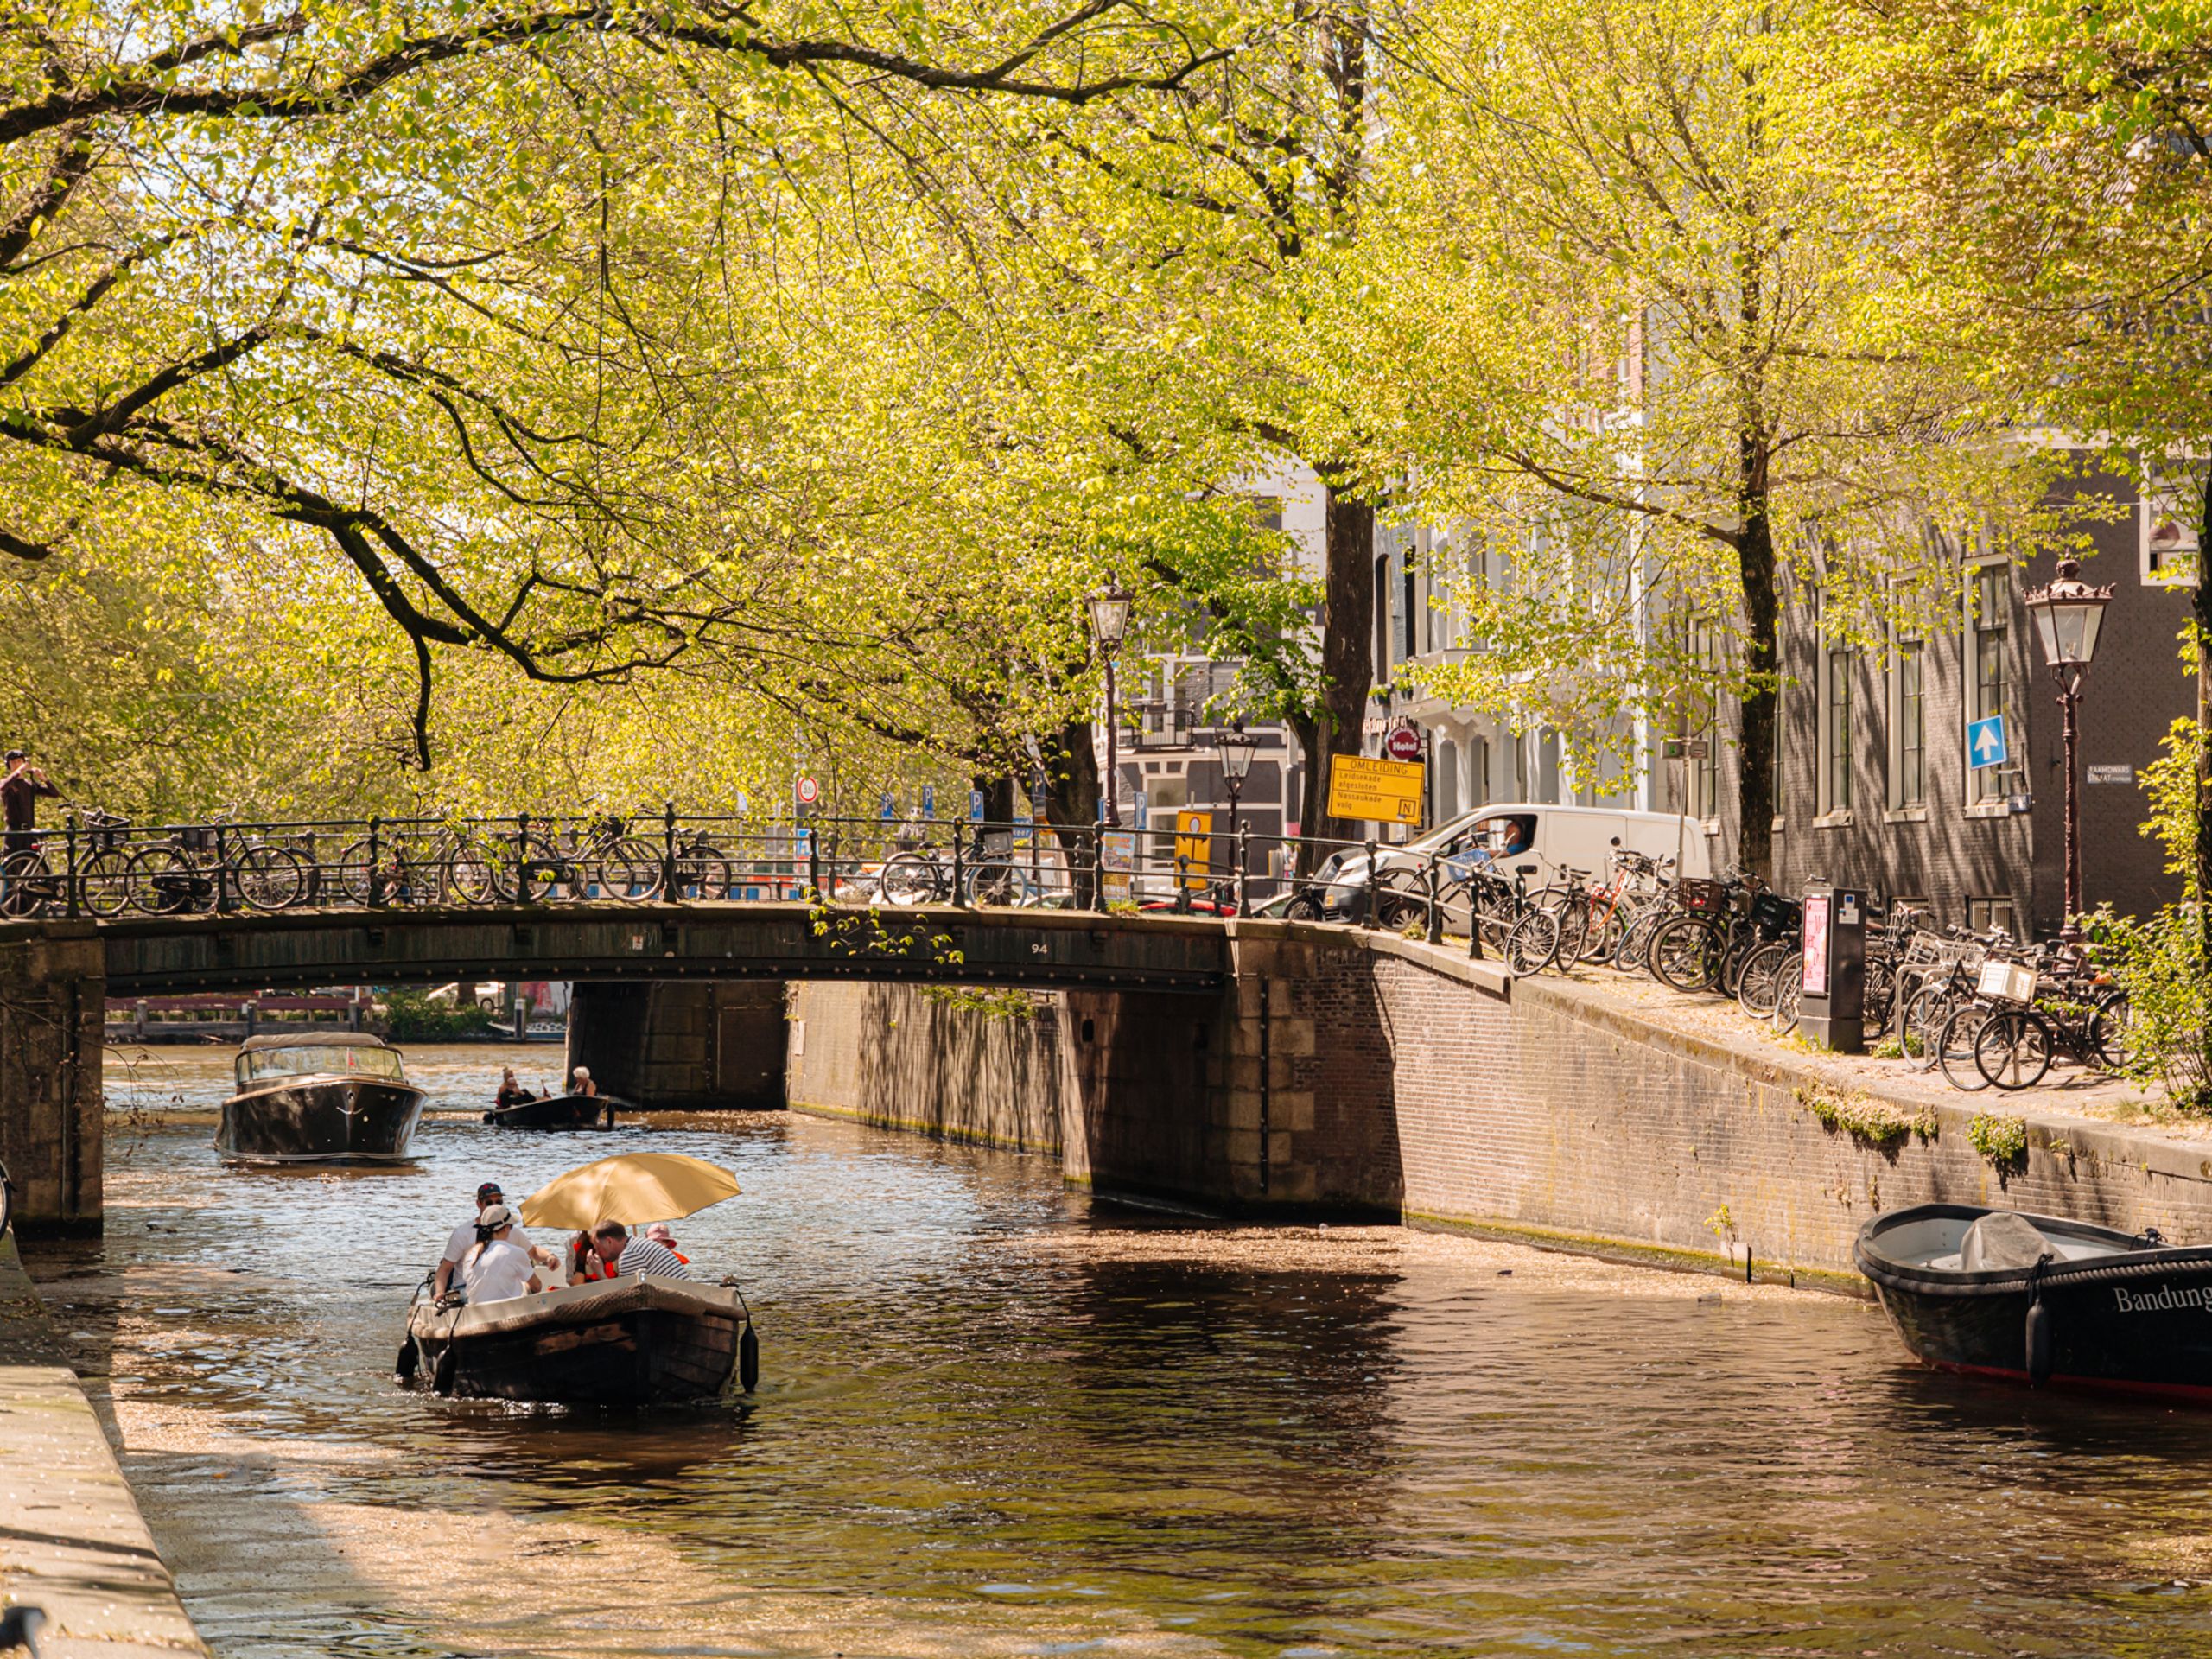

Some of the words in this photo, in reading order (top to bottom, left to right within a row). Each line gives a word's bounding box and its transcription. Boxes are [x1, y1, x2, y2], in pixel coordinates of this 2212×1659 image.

[1393, 741, 1417, 751] Hotel
[1351, 760, 1408, 774] OMLEIDING
[1339, 772, 1382, 783] Leidsekade
[1338, 782, 1378, 791] afgesloten
[925, 788, 931, 805] P
[1338, 791, 1382, 803] Nassaukade
[974, 794, 981, 812] P
[1337, 802, 1352, 810] volg
[1402, 803, 1412, 813] N
[1138, 796, 1145, 826] P
[1031, 943, 1048, 955] 94
[2113, 1283, 2212, 1313] Bandung
